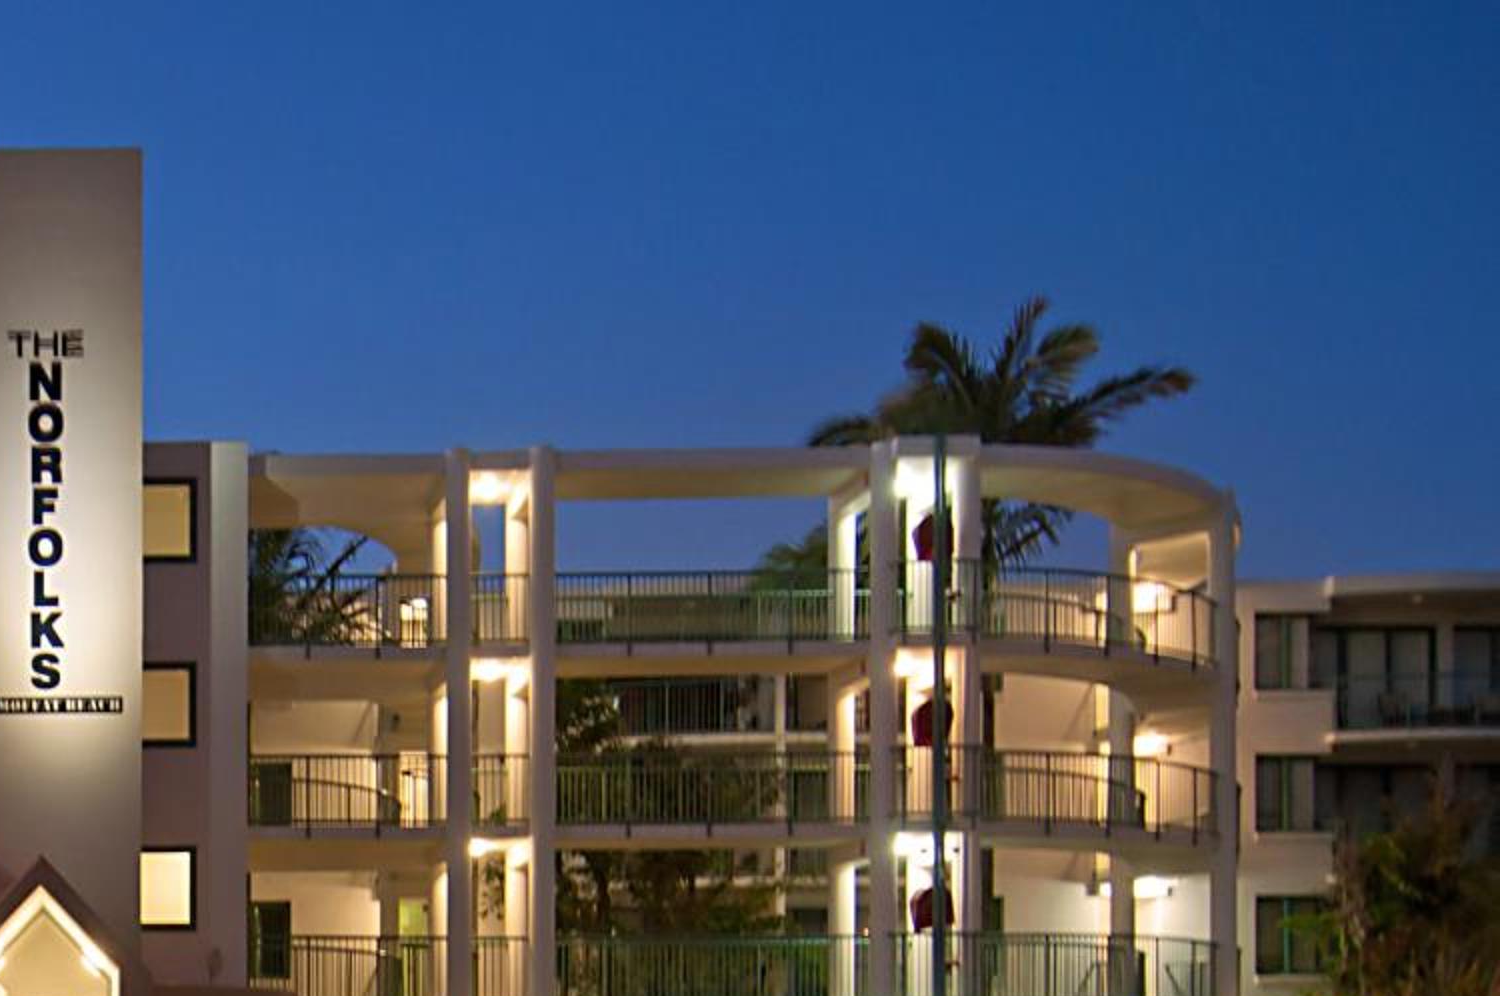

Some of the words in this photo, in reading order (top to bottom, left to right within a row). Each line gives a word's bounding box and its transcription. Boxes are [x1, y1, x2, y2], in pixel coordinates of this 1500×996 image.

[7, 329, 84, 357] THE
[28, 362, 64, 690] NORFOLKS
[65, 699, 121, 713] BEACH
